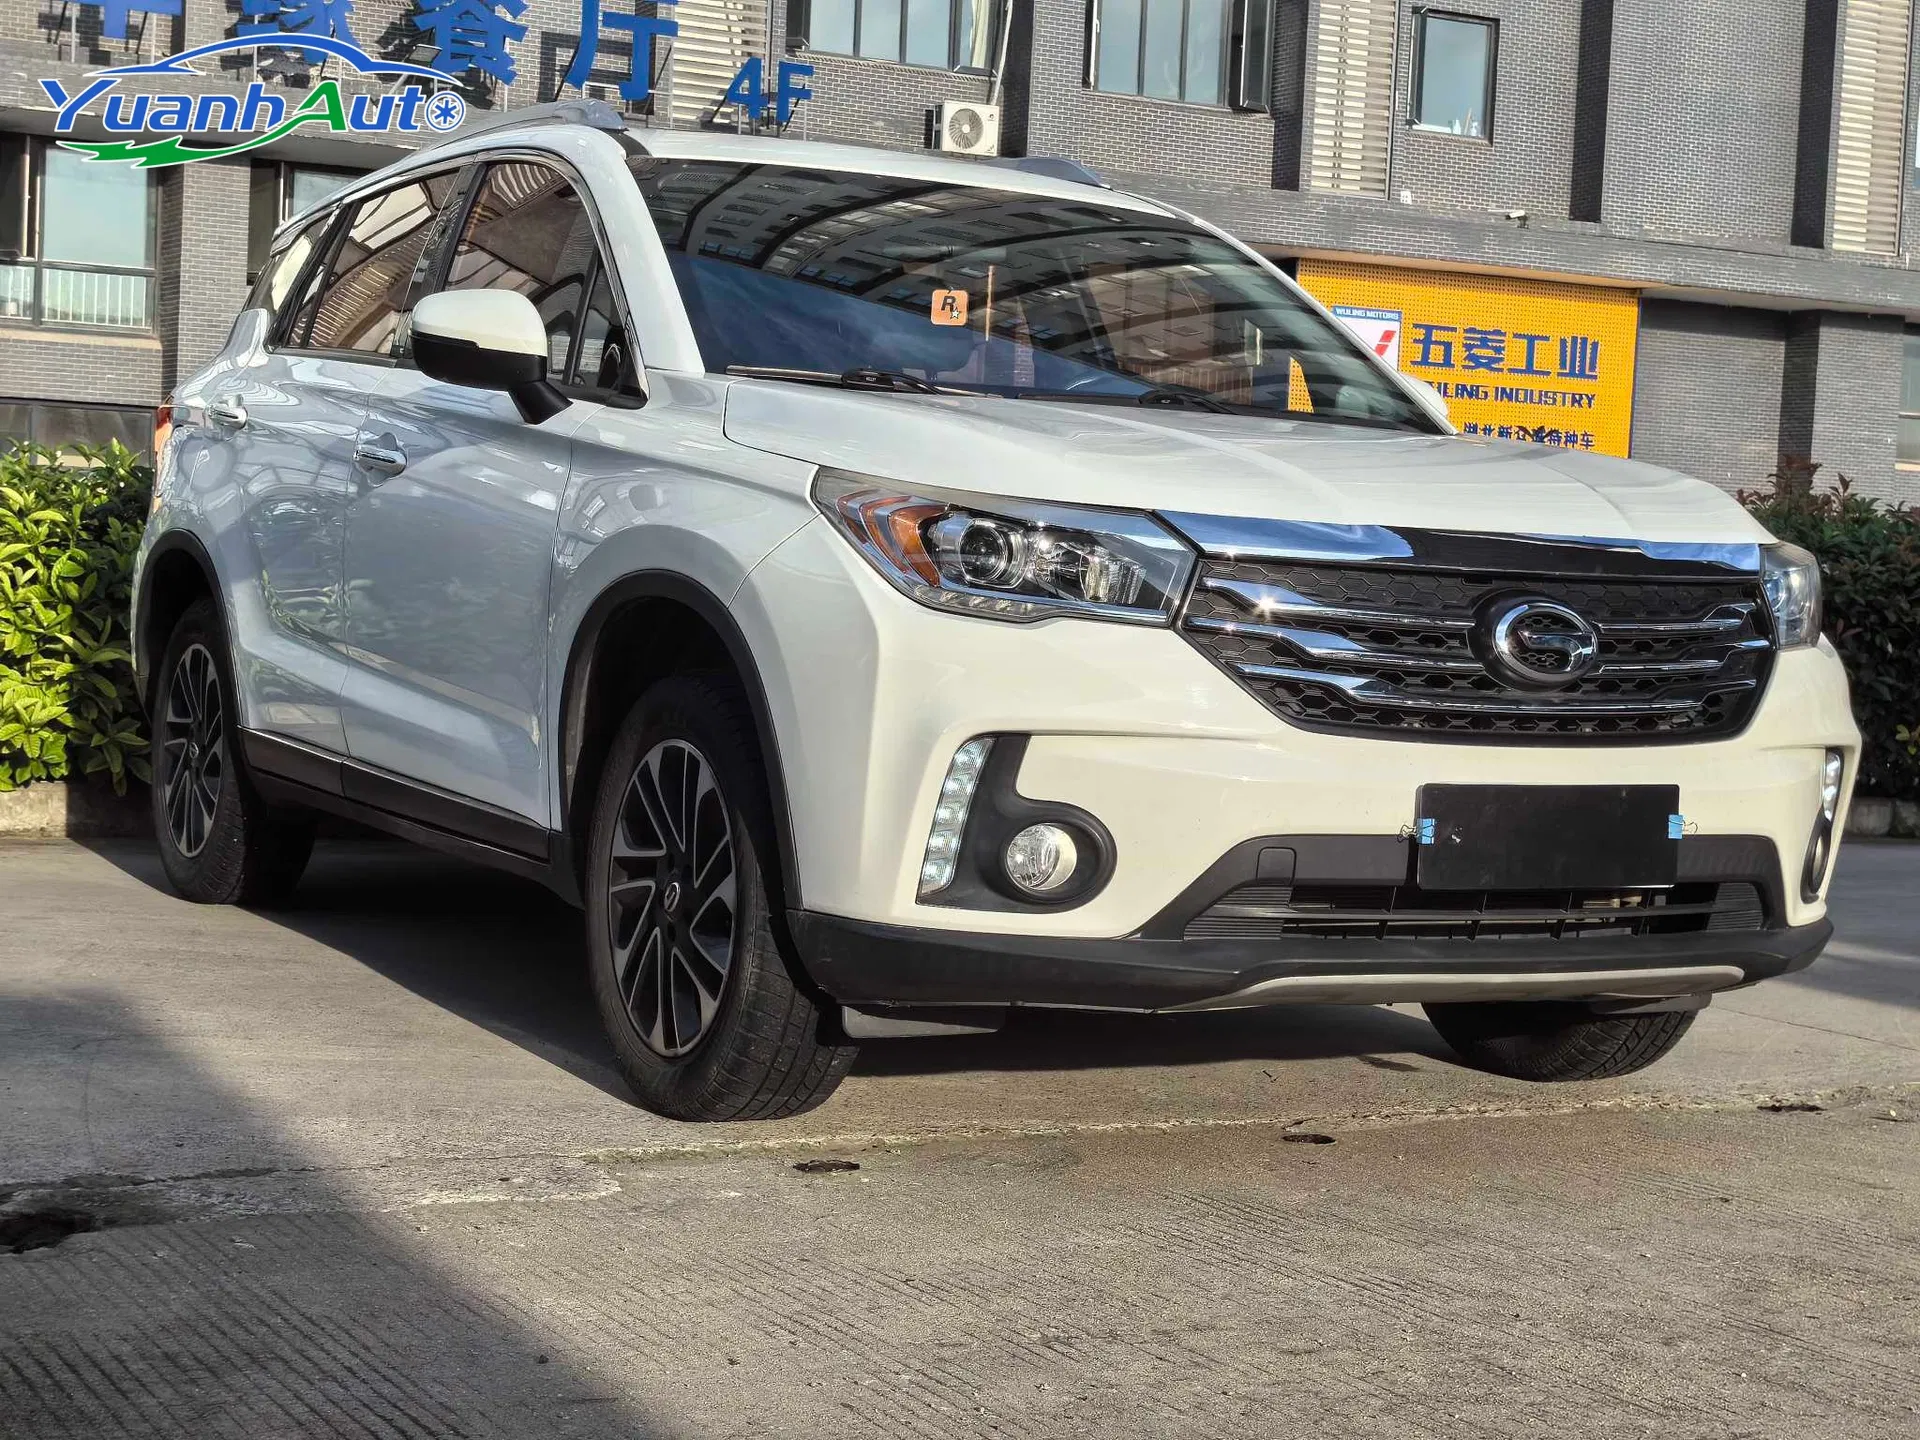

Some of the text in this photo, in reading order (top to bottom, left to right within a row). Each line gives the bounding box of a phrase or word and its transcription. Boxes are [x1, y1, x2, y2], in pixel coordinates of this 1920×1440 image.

[724, 57, 814, 124] 4F
[1335, 308, 1399, 320] WULING MOTORS
[1410, 323, 1599, 380] 五菱工业
[1494, 386, 1596, 409] INDUSTRY
